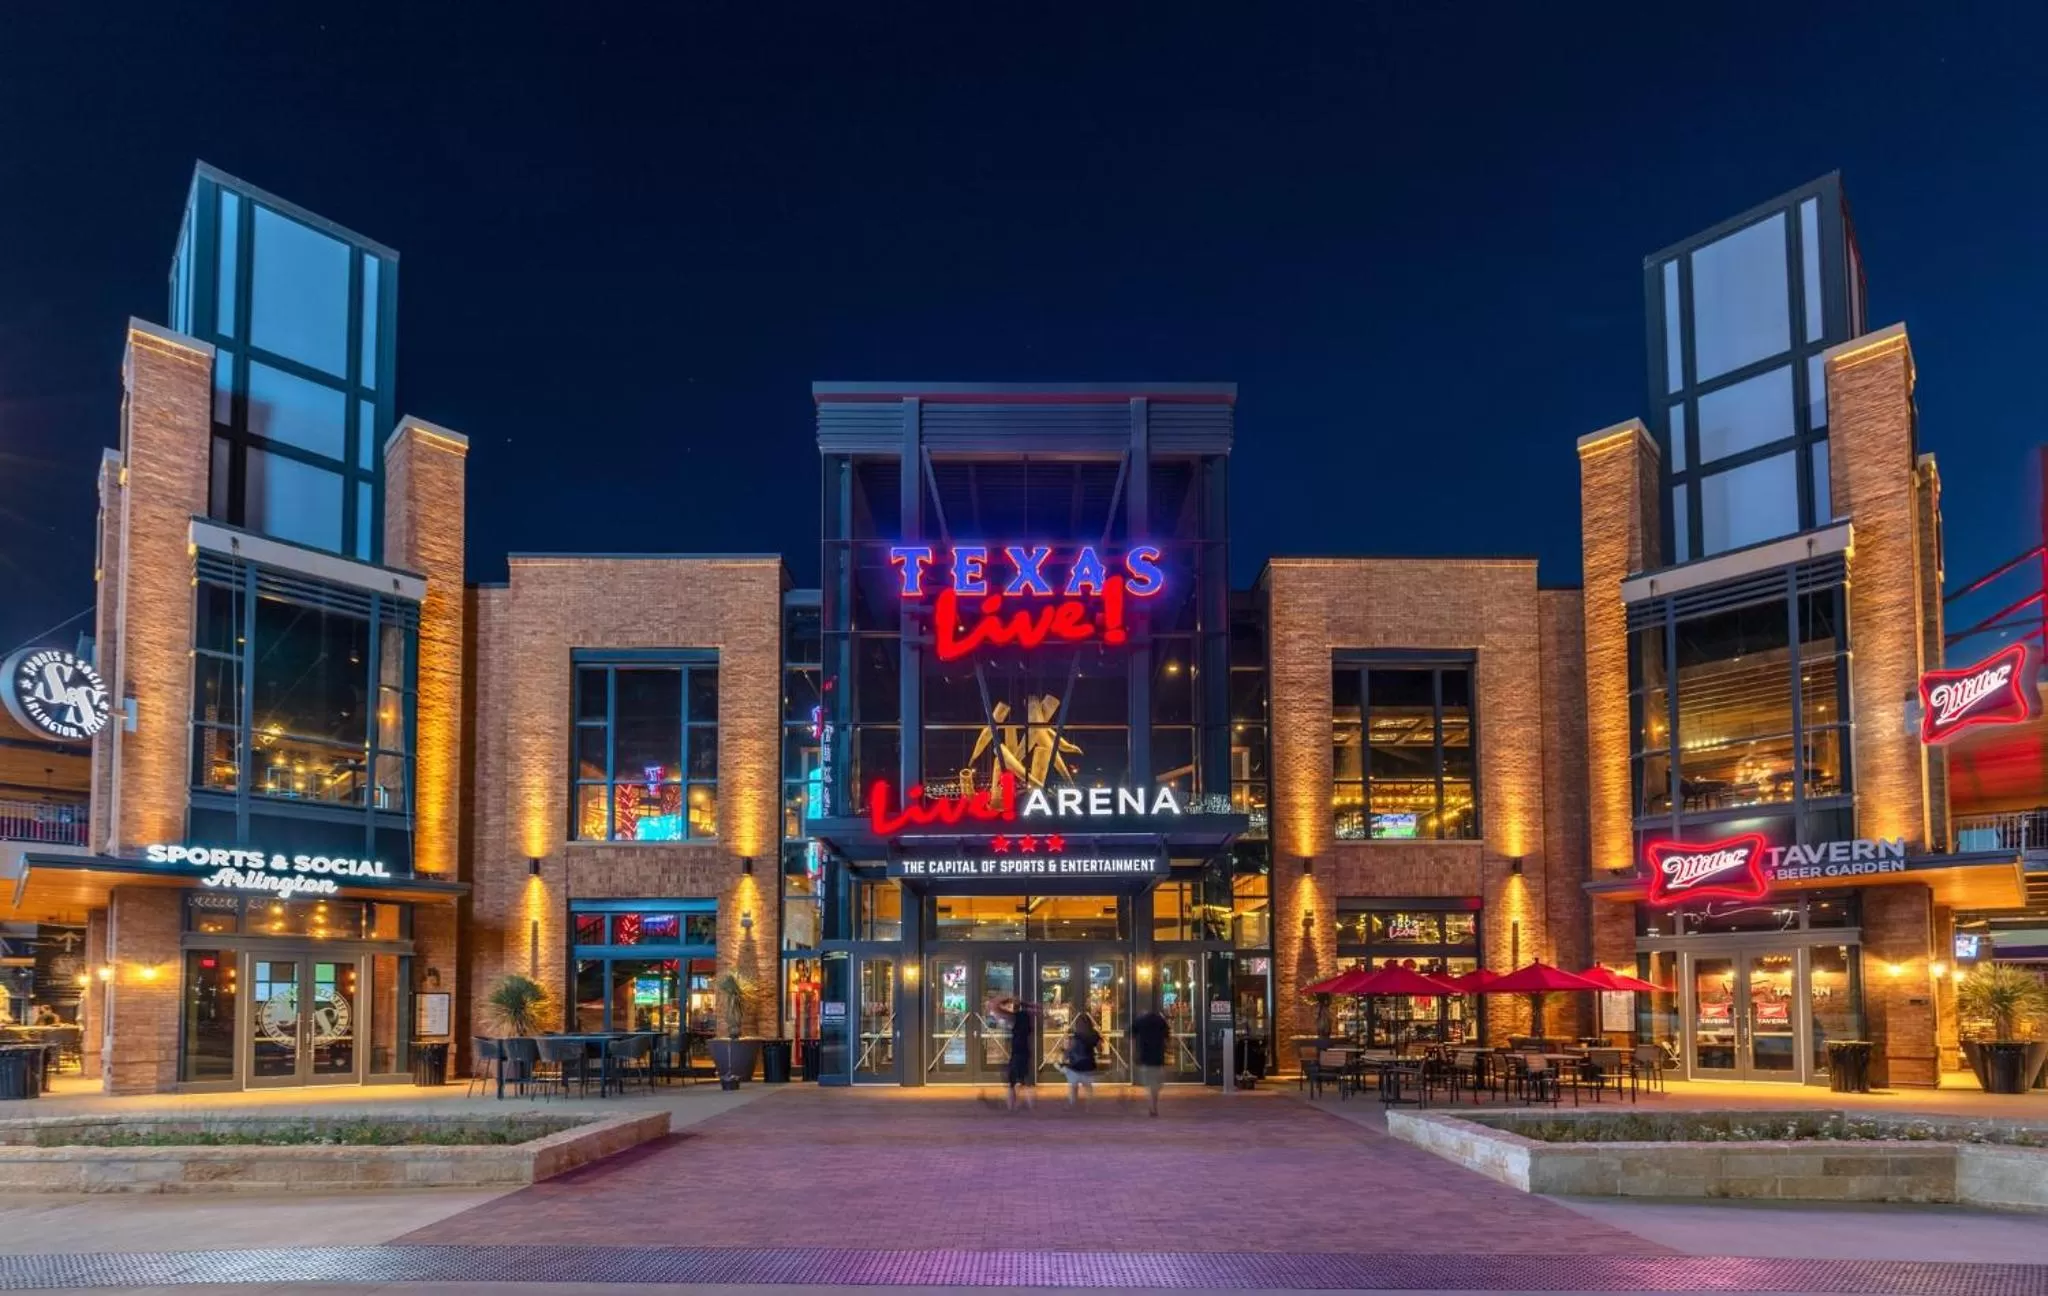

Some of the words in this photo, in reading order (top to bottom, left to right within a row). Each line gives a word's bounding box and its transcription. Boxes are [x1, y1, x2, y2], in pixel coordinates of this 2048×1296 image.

[890, 546, 1164, 597] TEXAS
[936, 575, 1127, 661] Live!
[22, 651, 62, 676] SPORTS
[1931, 664, 2012, 725] Miller
[869, 770, 1018, 836] Live!
[1023, 787, 1182, 817] ARENA
[147, 844, 265, 869] SPORTS
[270, 854, 289, 871] &
[294, 854, 391, 878] SOCIAL
[903, 860, 925, 873] THE
[929, 860, 978, 873] CAPITAL
[982, 860, 997, 873] OF
[1000, 860, 1045, 873] SPORTS
[1048, 860, 1057, 872] &
[1061, 859, 1156, 872] ENTERTAINMENT
[1661, 848, 1750, 889] Miller
[1765, 836, 1906, 867] TAVERN
[202, 867, 338, 898] Arlington
[1777, 867, 1822, 881] BEER
[1826, 859, 1906, 876] GARDEN
